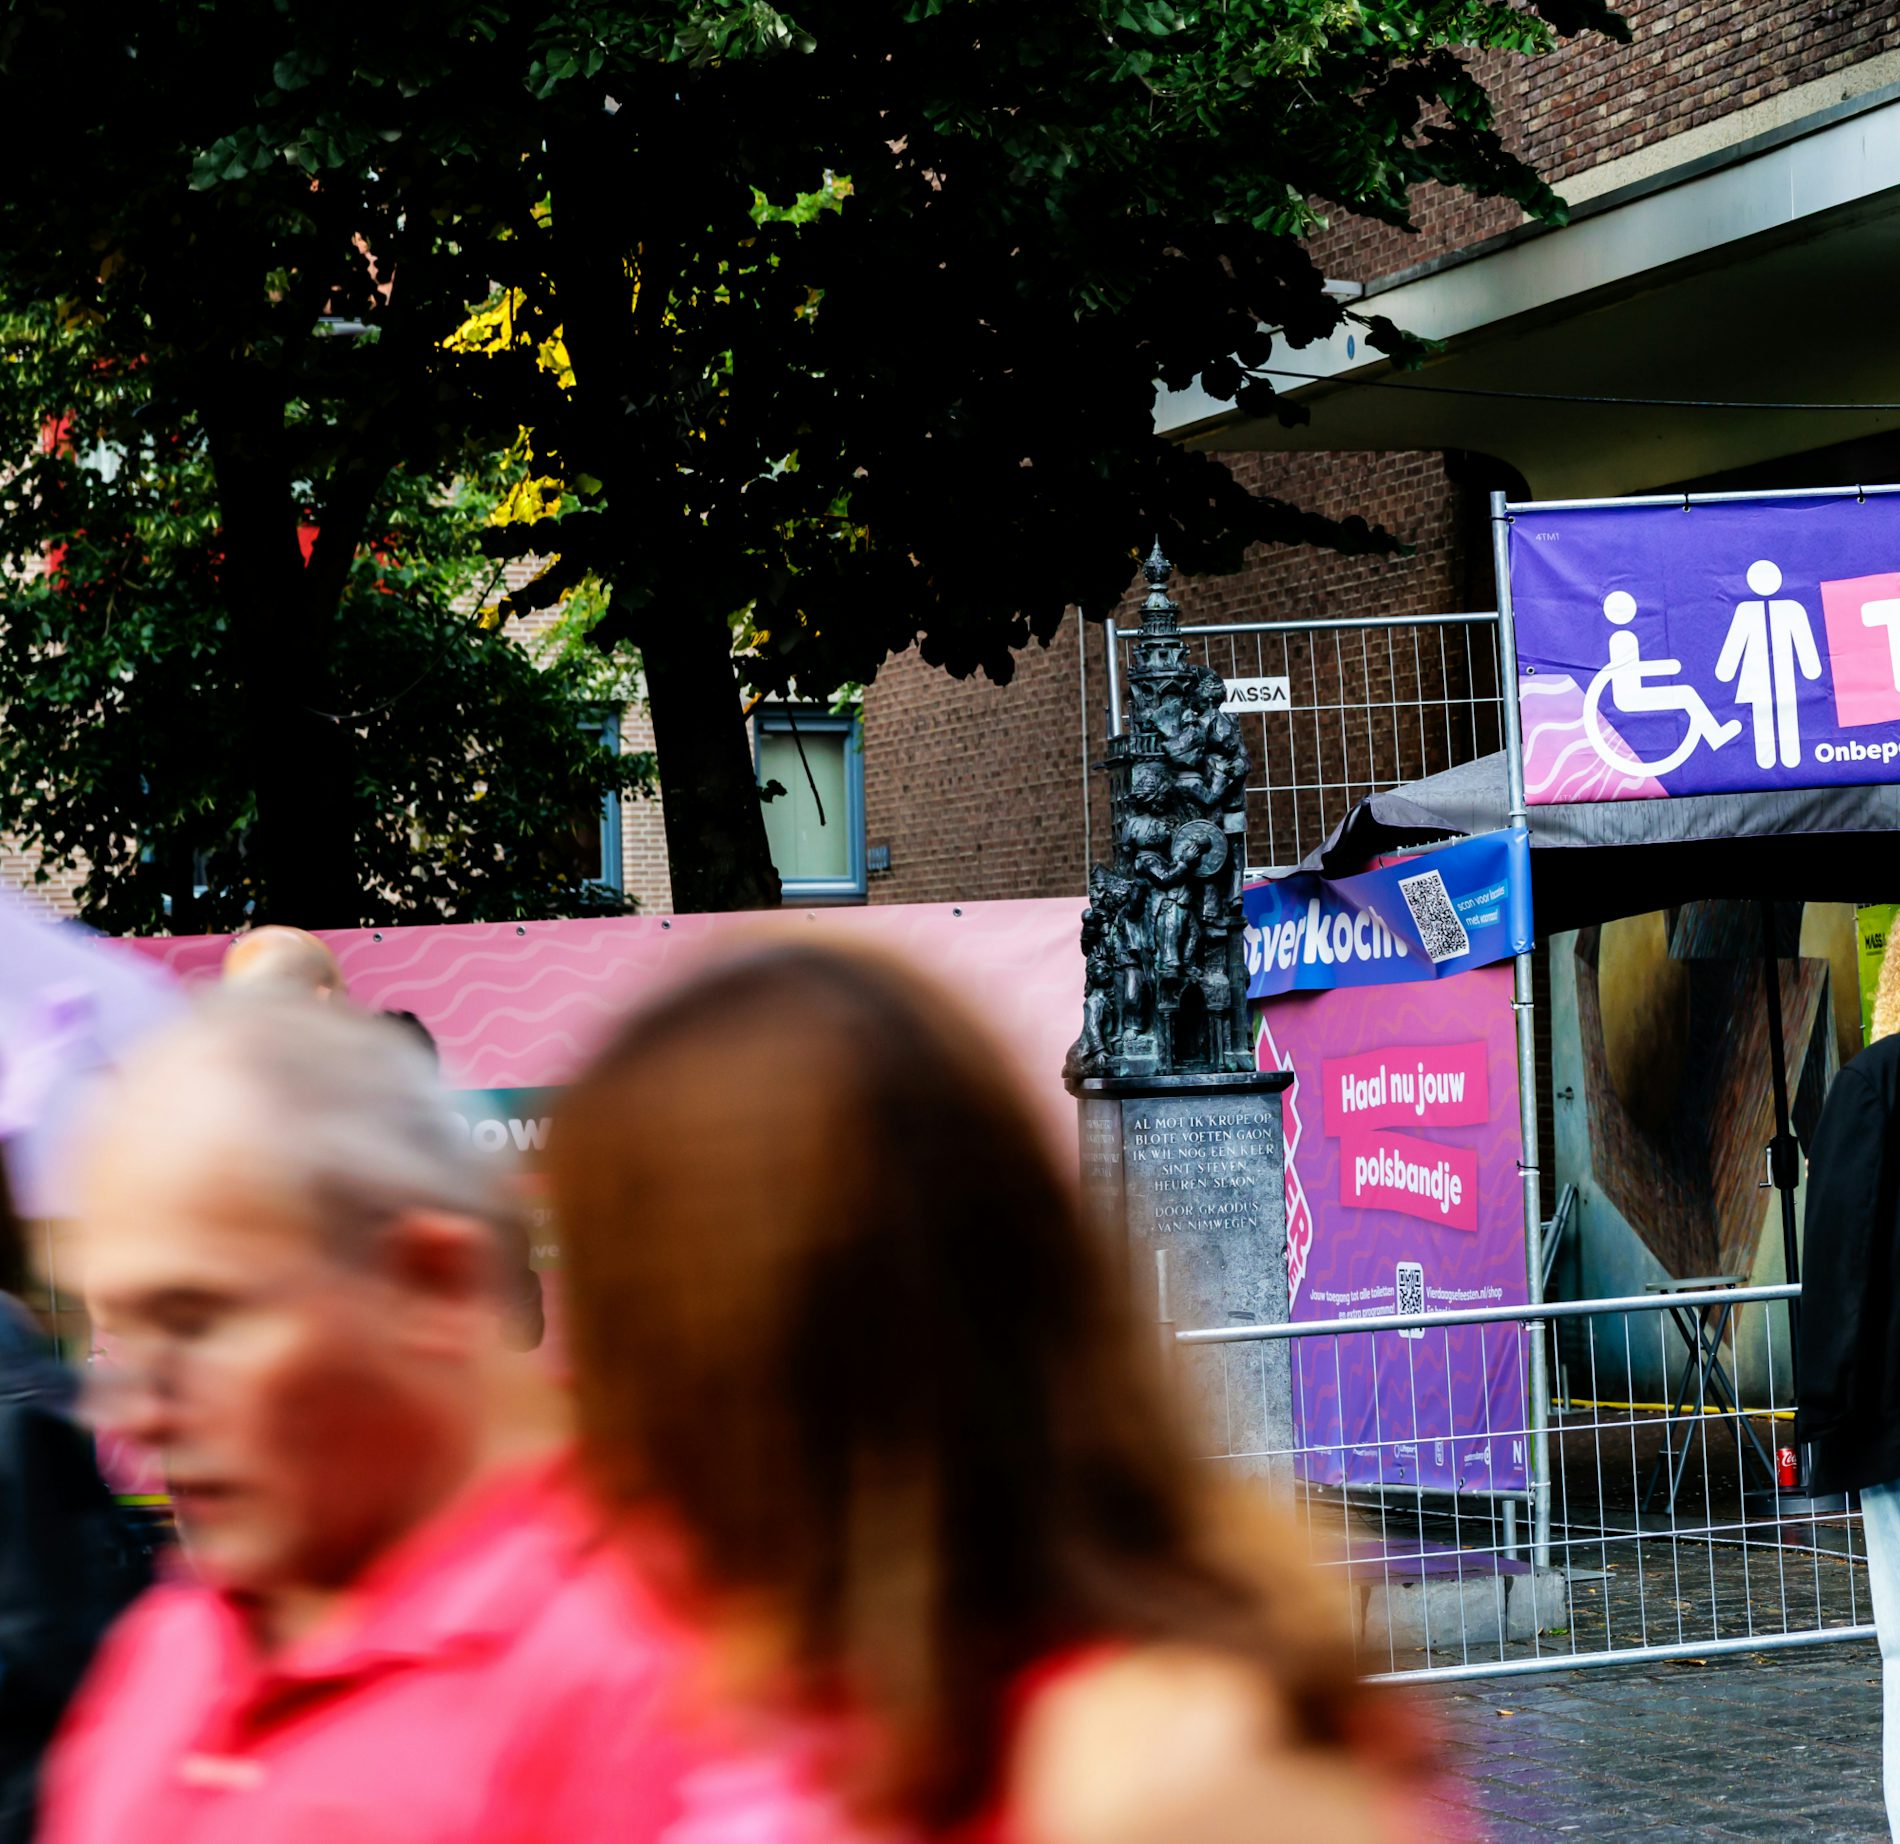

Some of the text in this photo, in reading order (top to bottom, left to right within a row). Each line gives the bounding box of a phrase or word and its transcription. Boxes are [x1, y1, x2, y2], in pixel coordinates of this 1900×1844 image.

[1225, 685, 1287, 703] ASSA
[1243, 898, 1409, 976] tverkoch
[1341, 1062, 1465, 1116] Haal nu jouw
[1134, 1113, 1272, 1130] AL MOT IK KRUPE OP
[1135, 1128, 1272, 1146] BLOTE VOETEN GAON
[1133, 1149, 1146, 1161] IK
[1151, 1148, 1174, 1160] WIL
[1178, 1147, 1206, 1159] NOG
[1211, 1145, 1236, 1157] EEN
[1161, 1161, 1246, 1176] SINT STEVEN
[1154, 1178, 1207, 1192] HEUREN
[1355, 1147, 1462, 1214] polsbandje
[1155, 1205, 1193, 1218] DOOR
[1157, 1221, 1182, 1233] VAN
[1310, 1288, 1326, 1301] Jouw
[1325, 1291, 1350, 1306] toegang
[1350, 1289, 1359, 1302] tot
[1370, 1285, 1395, 1299] toiletten
